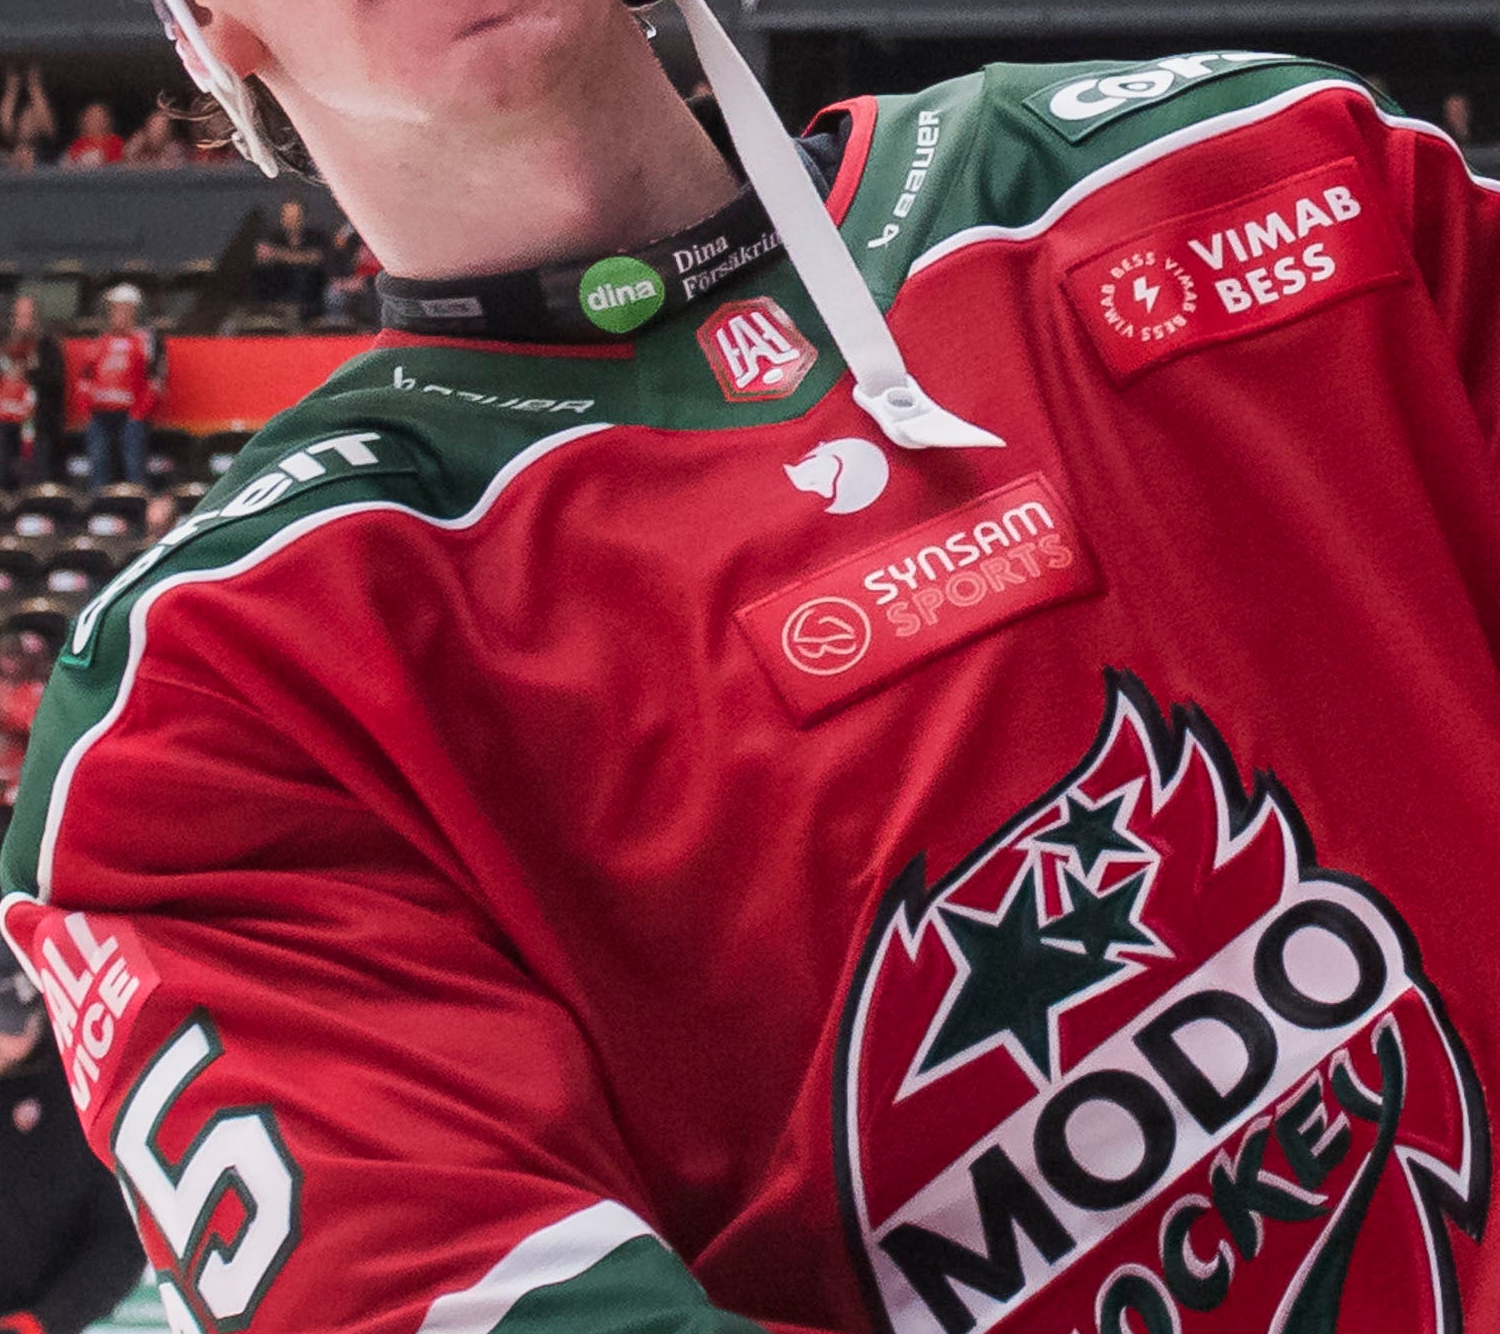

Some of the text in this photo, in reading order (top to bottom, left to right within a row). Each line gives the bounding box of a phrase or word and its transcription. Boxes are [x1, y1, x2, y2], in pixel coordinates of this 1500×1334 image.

[894, 108, 941, 218] BAUER
[671, 235, 730, 275] Dina
[1187, 184, 1362, 271] VIMAB
[586, 279, 658, 312] dina
[1099, 251, 1198, 343] BESS VIMAB BESS VIMAB
[1213, 243, 1337, 315] BESS
[863, 500, 1055, 606] SYNSAM
[885, 533, 1075, 639] SPORTS
